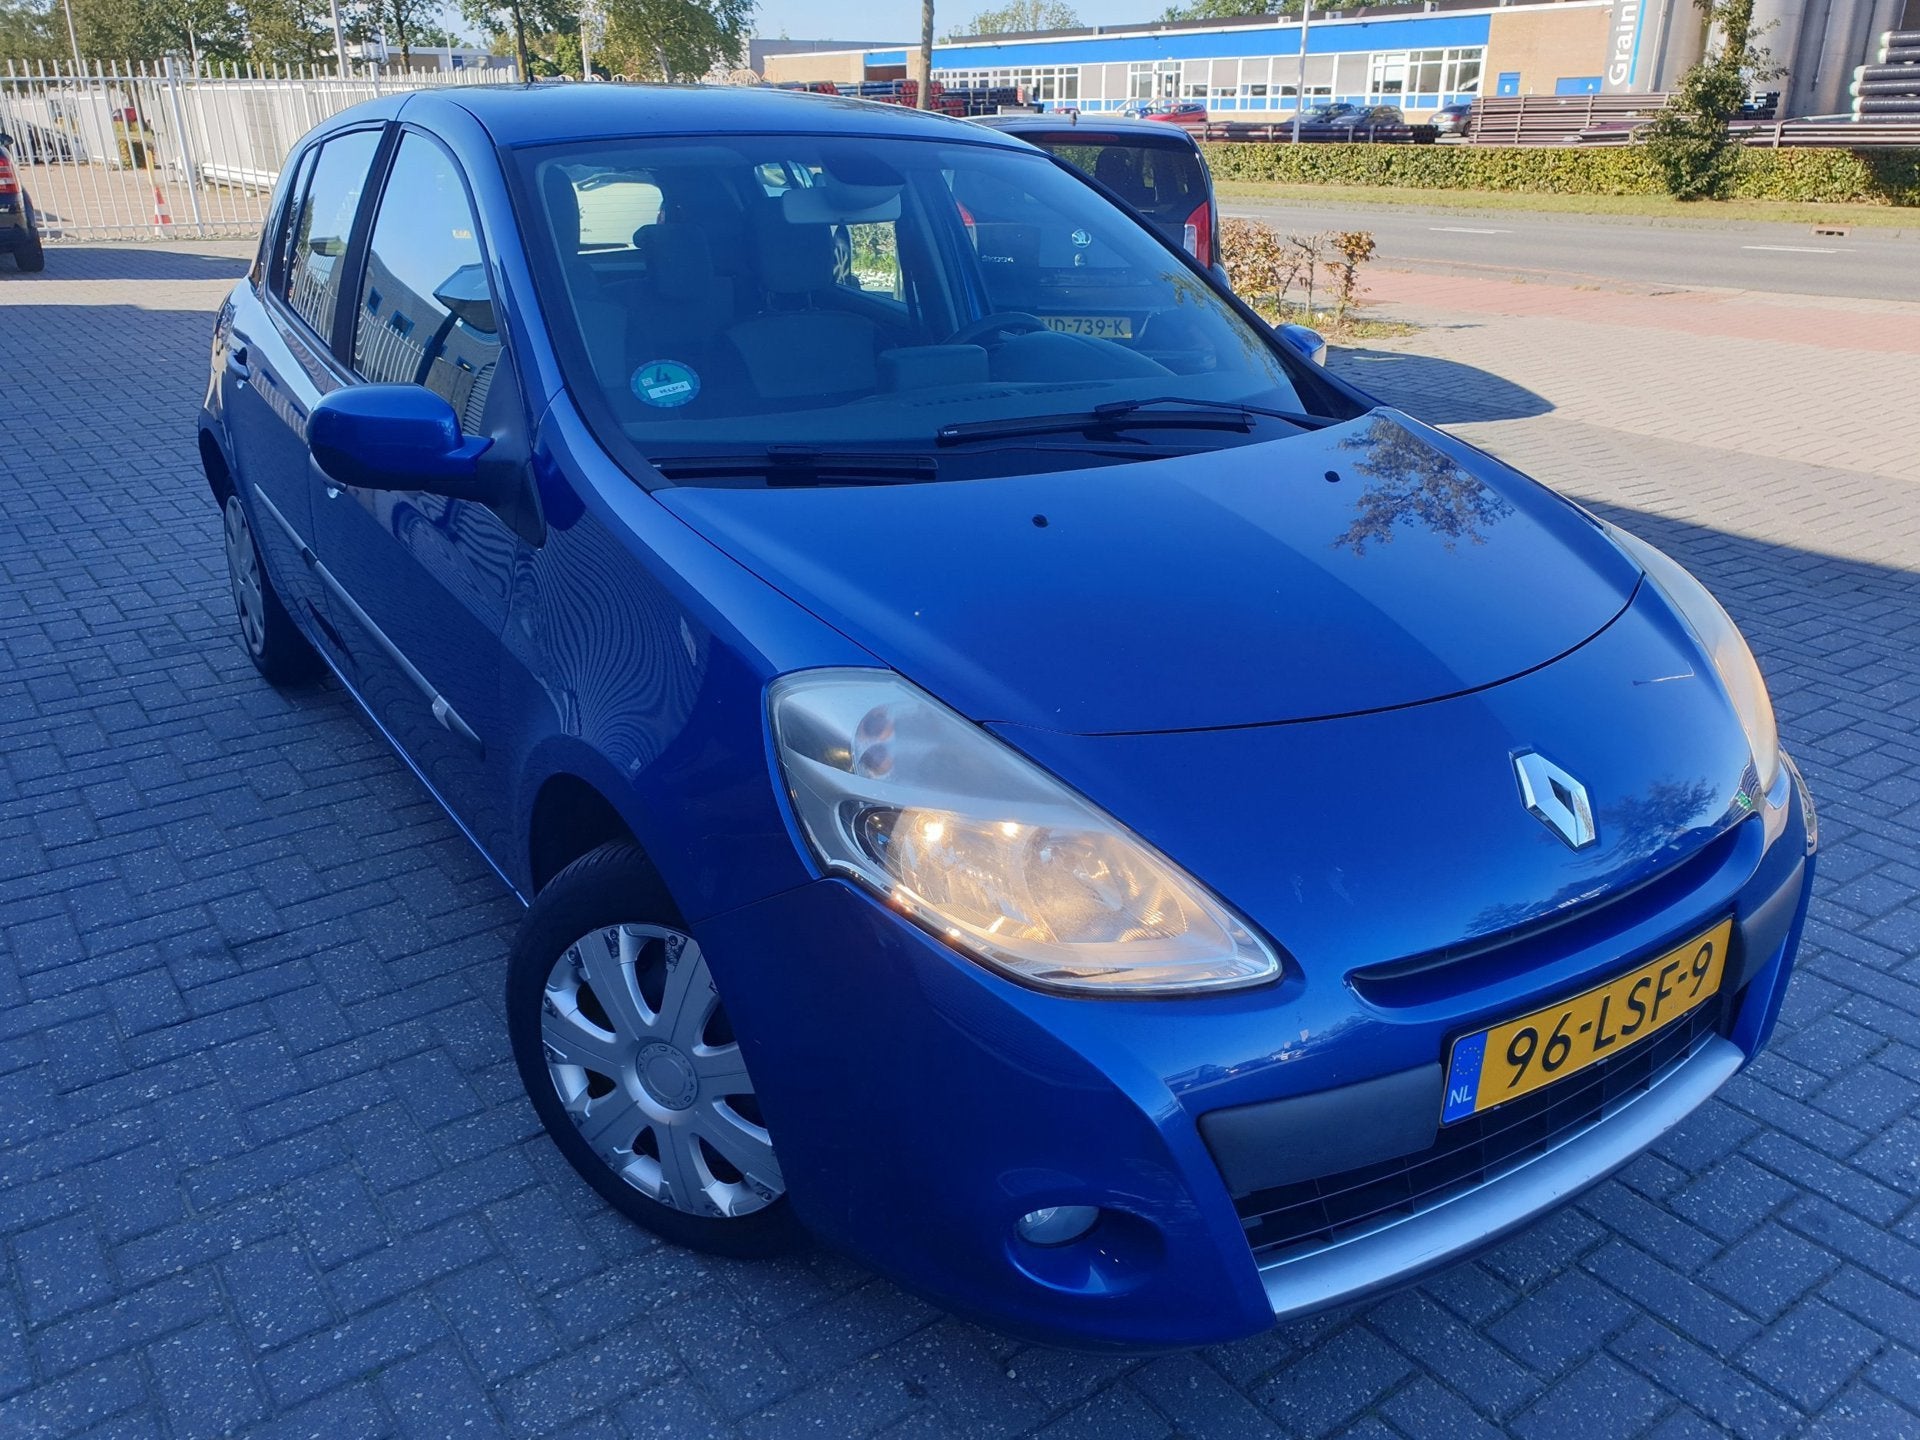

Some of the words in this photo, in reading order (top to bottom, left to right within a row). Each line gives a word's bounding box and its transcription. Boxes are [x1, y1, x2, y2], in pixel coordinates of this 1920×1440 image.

[1608, 0, 1640, 85] Grain
[1506, 941, 1714, 1088] 96-LSF-9
[1449, 1085, 1473, 1107] NL
